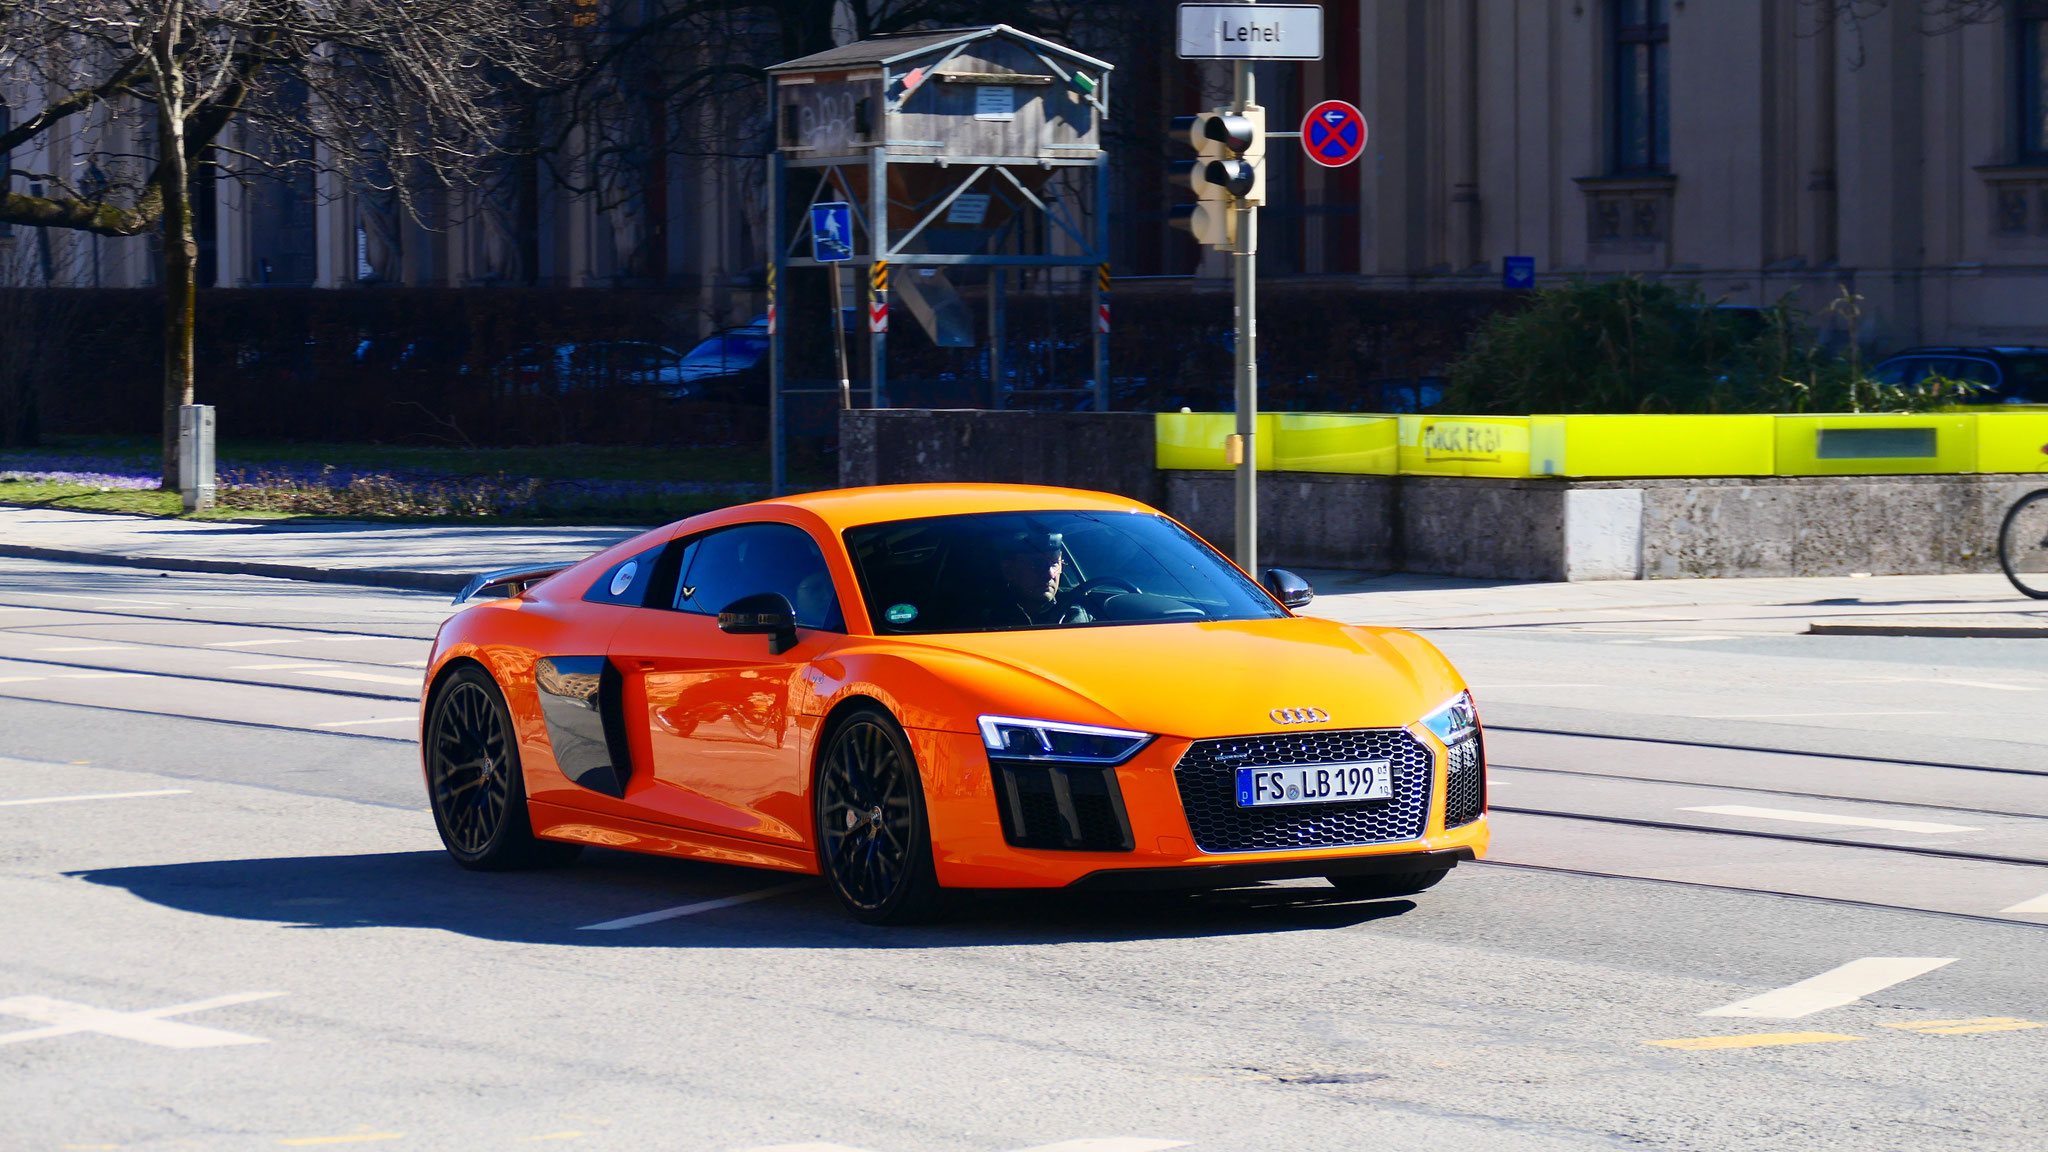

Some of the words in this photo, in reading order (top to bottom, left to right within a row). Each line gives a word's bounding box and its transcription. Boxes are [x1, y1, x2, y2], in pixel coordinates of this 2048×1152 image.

[1223, 20, 1280, 42] Lehel
[1255, 772, 1285, 801] FS
[1302, 769, 1331, 798] LB
[1335, 767, 1374, 796] 199
[1242, 791, 1249, 800] D
